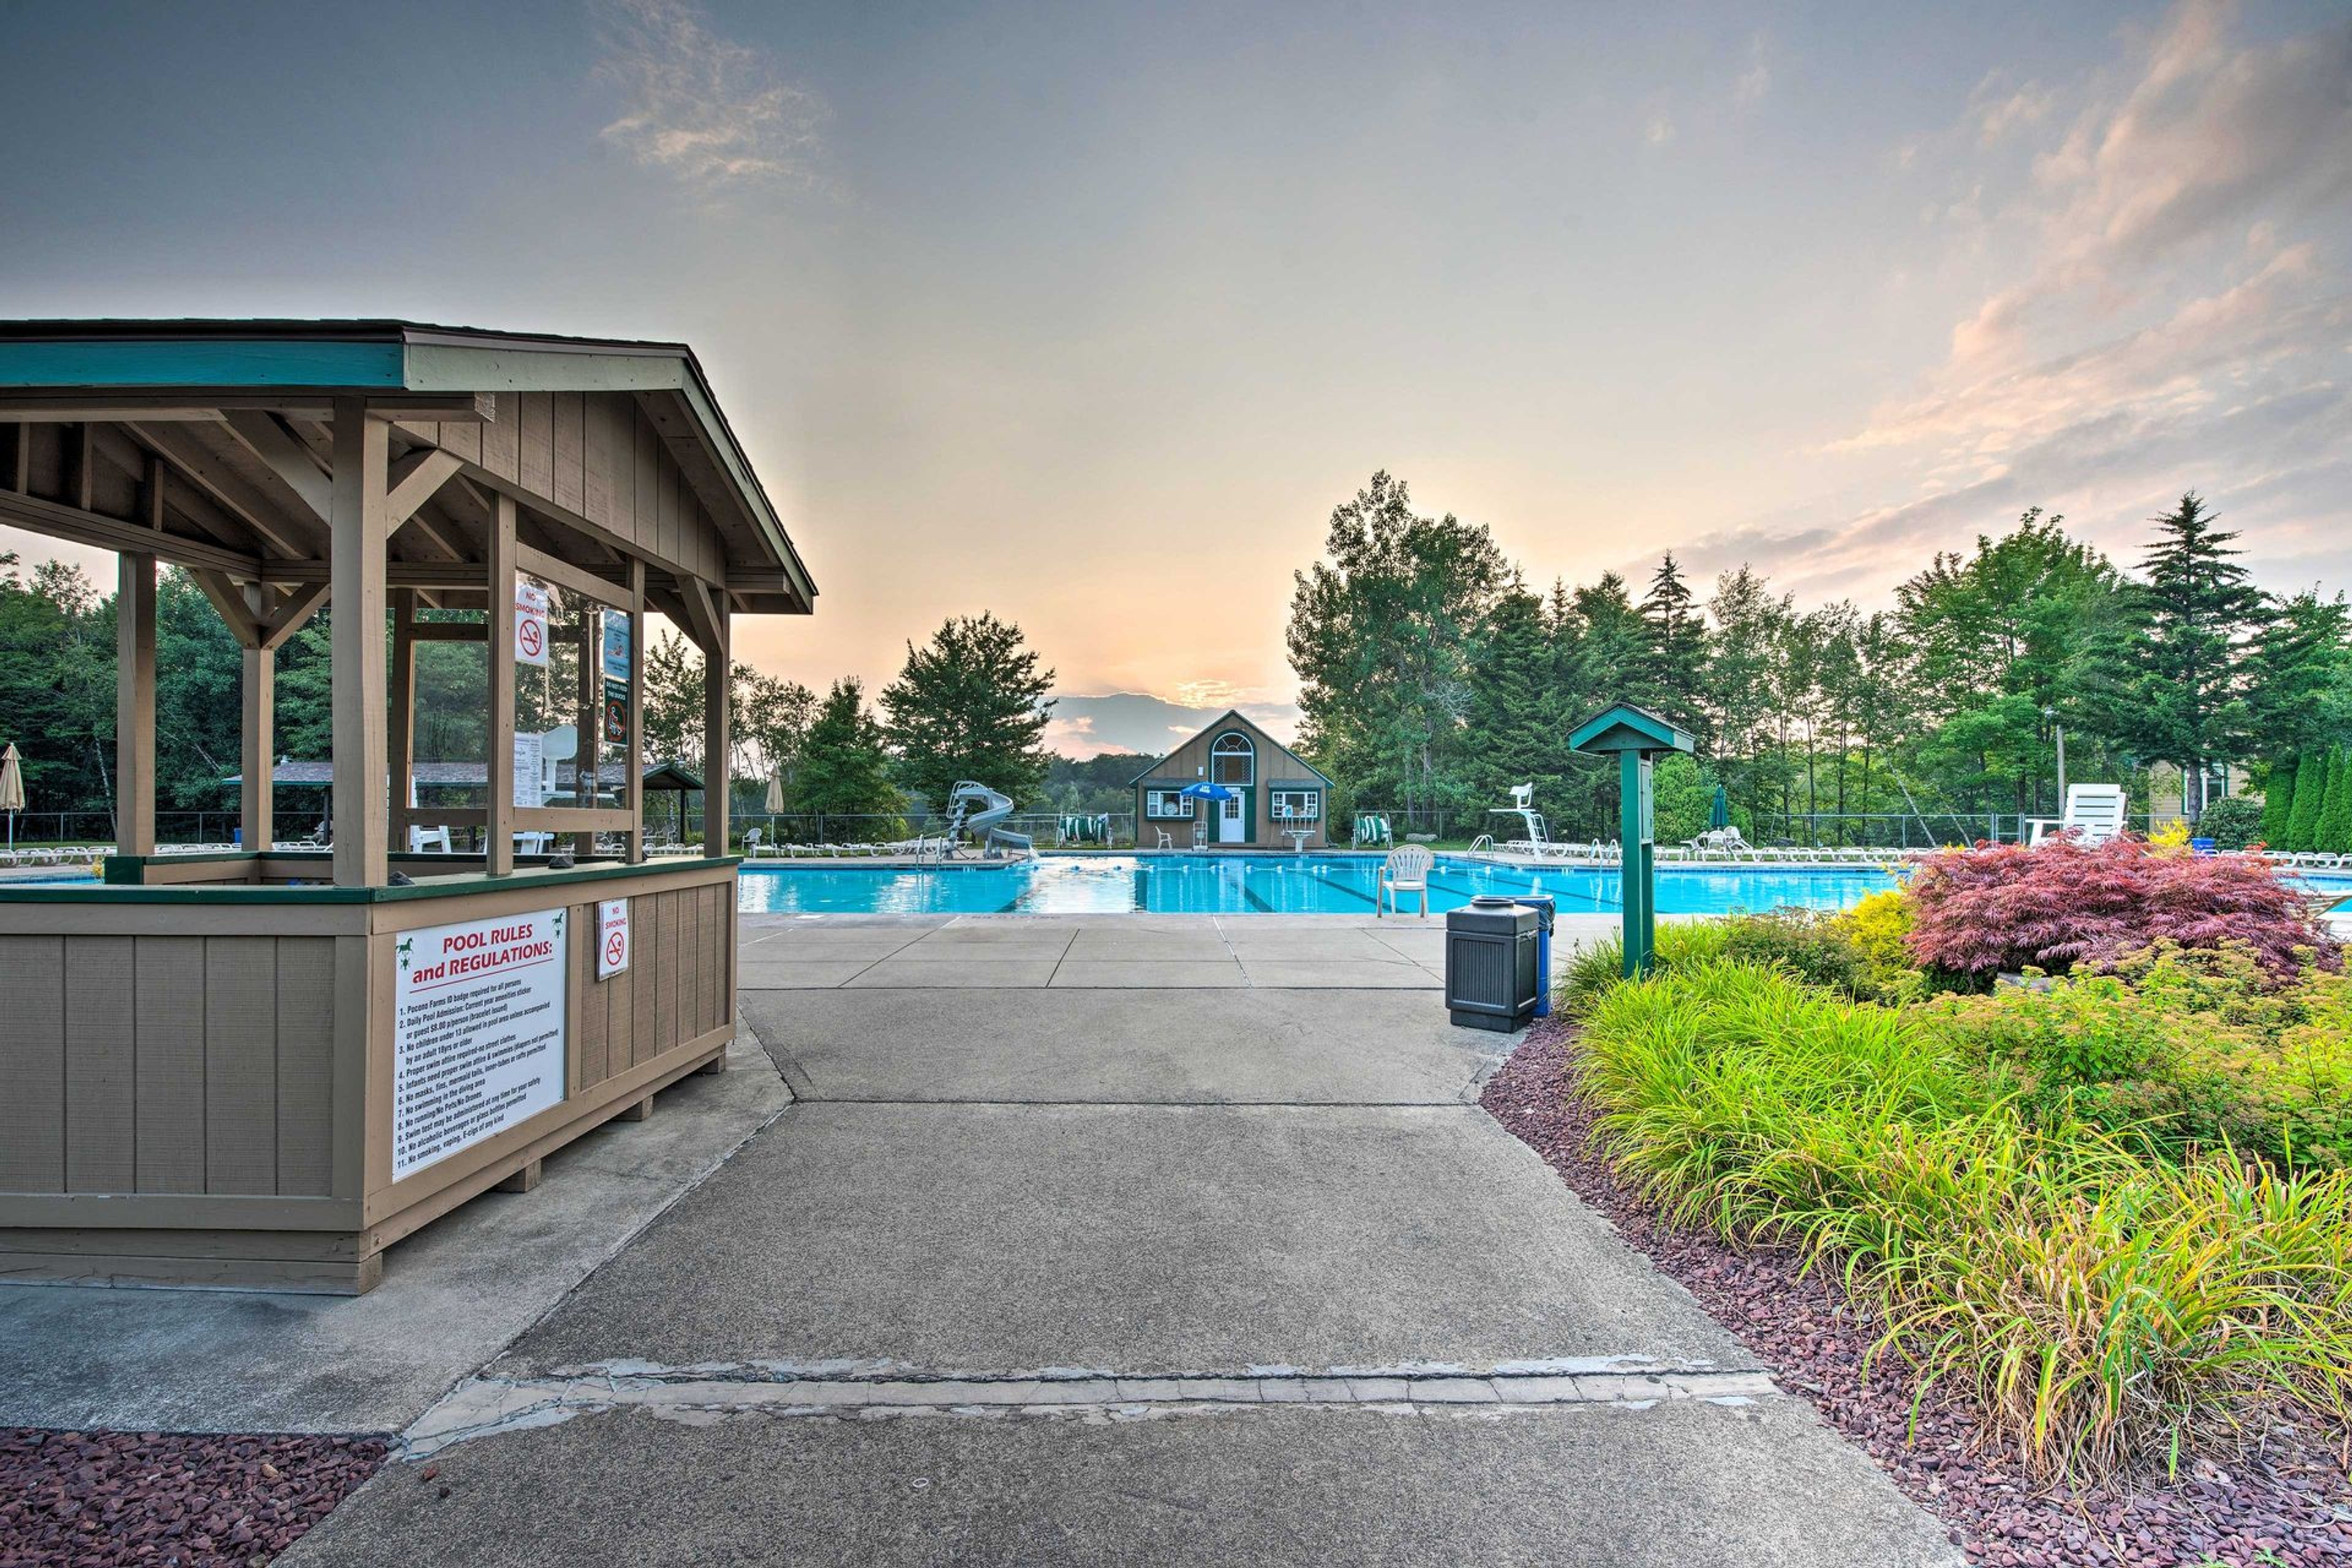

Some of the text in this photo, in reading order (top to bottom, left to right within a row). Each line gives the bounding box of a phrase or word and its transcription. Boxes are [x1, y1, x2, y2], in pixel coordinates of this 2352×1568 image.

[515, 603, 545, 617] SMOKING
[526, 592, 536, 601] NO
[443, 924, 532, 954] POOL RULES
[606, 918, 626, 929] SMOKING
[412, 941, 552, 983] and REGULATIONS:
[407, 1003, 428, 1013] Pocono
[429, 998, 445, 1008] Farms
[453, 993, 468, 1001] badge
[469, 986, 489, 997] required
[505, 979, 521, 990] persons
[407, 1016, 421, 1026] Daily
[423, 1012, 435, 1022] Pool
[465, 999, 483, 1010] Current
[484, 998, 494, 1006] year
[495, 992, 516, 1001] amenities
[413, 1025, 429, 1039] guest
[415, 1037, 438, 1049] children
[440, 1032, 454, 1041] under
[463, 1022, 481, 1034] allowed
[488, 1017, 497, 1028] pool
[405, 1057, 412, 1065] by
[423, 1048, 436, 1058] adult
[459, 1038, 472, 1047] older
[407, 1065, 425, 1077] Proper
[426, 1060, 440, 1070] swim
[442, 1055, 456, 1065] attire
[485, 1039, 499, 1049] street
[500, 1035, 516, 1044] clothes
[398, 1084, 404, 1092] 5.
[406, 1077, 426, 1089] Infants
[427, 1071, 440, 1082] need
[441, 1066, 458, 1078] proper
[459, 1061, 472, 1070] swim
[473, 1056, 485, 1065] attire
[398, 1096, 404, 1105] 6.
[449, 1072, 470, 1085] mermaid
[516, 1052, 526, 1060] rafts
[527, 1044, 546, 1058] permitted
[405, 1129, 420, 1140] Swim
[421, 1121, 432, 1133] test
[434, 1118, 445, 1128] may
[453, 1100, 484, 1119] administered
[518, 1084, 527, 1093] your
[528, 1077, 540, 1087] safety
[414, 1096, 441, 1111] swimming
[459, 1084, 473, 1093] diving
[465, 1091, 481, 1102] Drones
[398, 1146, 407, 1156] 10.
[417, 1131, 442, 1147] alcoholic
[443, 1120, 469, 1136] beverages
[477, 1112, 488, 1123] glass
[490, 1104, 505, 1115] bottles
[506, 1093, 526, 1109] permitted
[398, 1159, 406, 1169] 11.
[479, 1123, 484, 1131] of
[494, 1114, 503, 1125] kind
